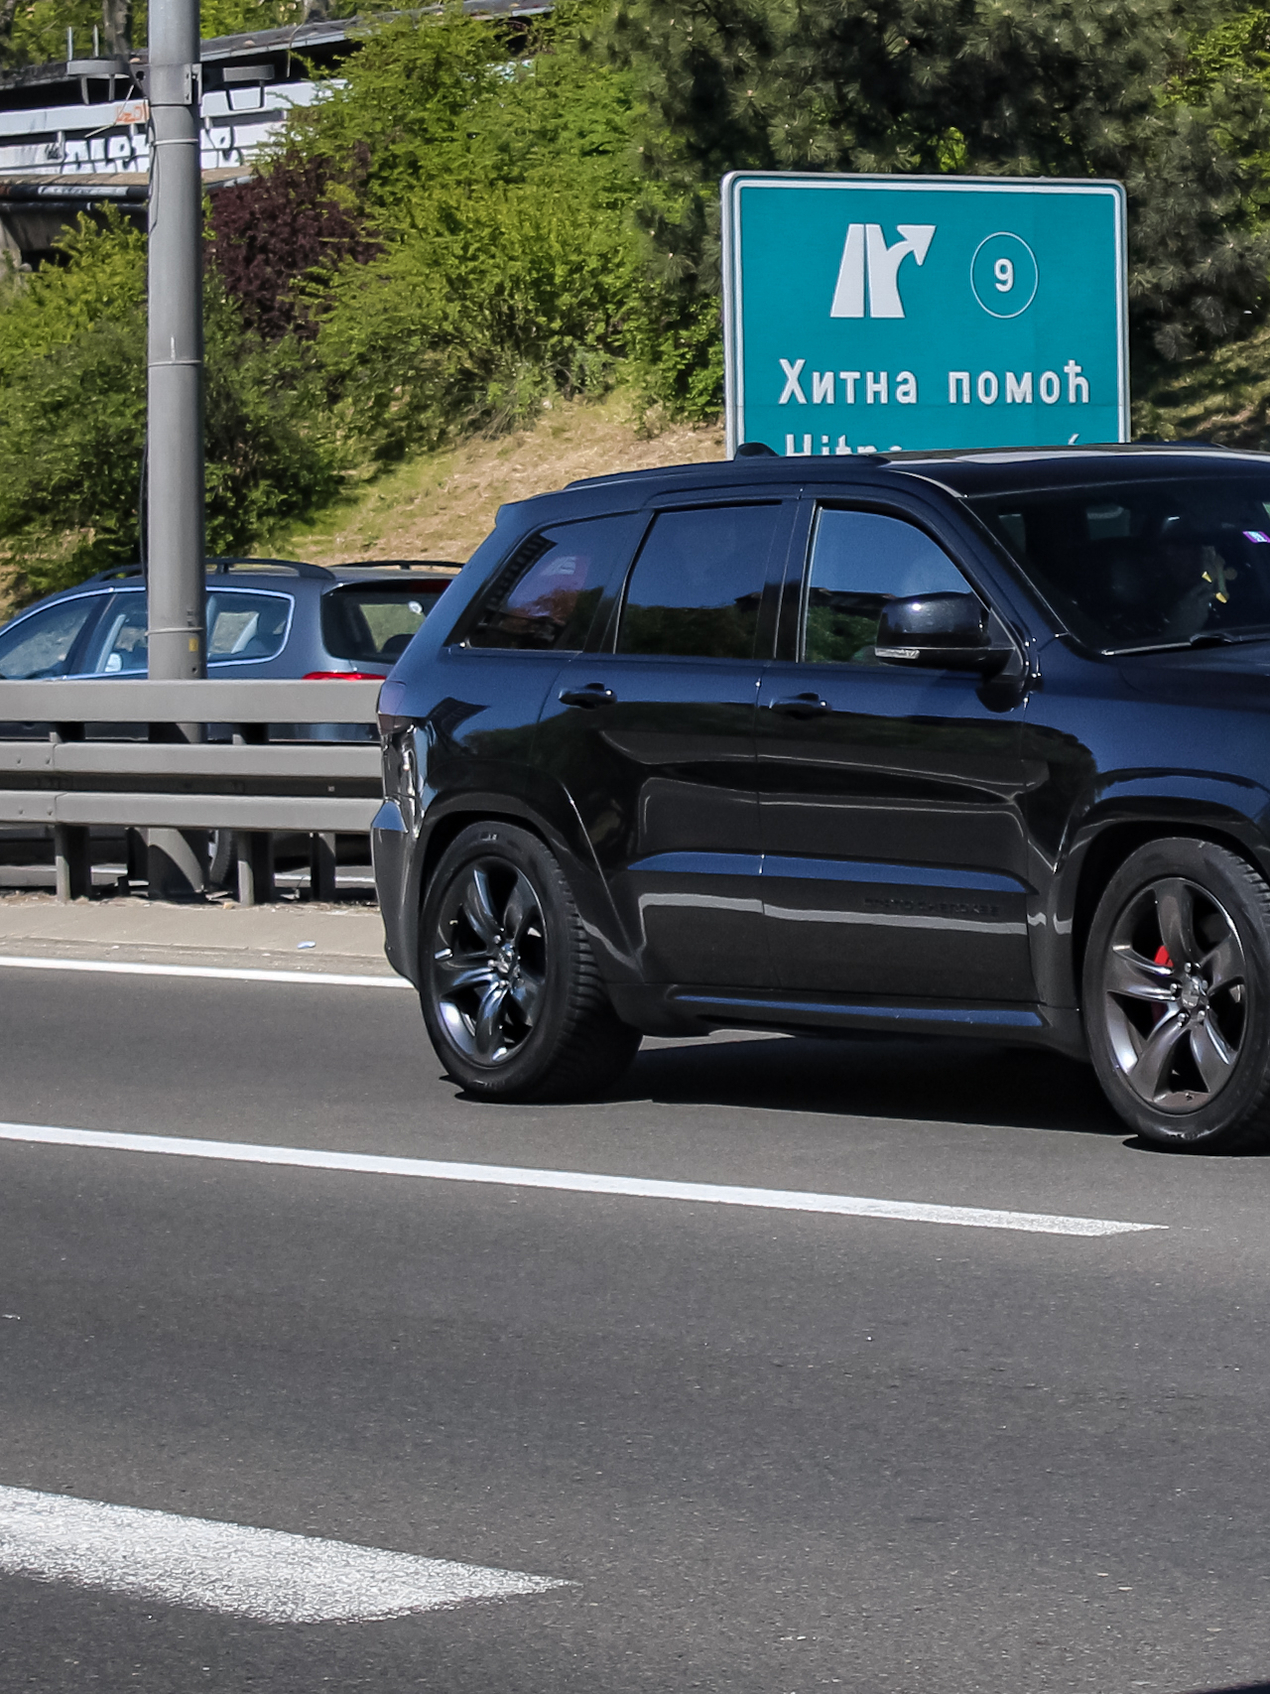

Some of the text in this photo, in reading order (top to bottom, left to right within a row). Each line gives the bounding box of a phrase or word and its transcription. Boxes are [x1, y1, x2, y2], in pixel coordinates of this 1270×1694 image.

[993, 258, 1014, 292] 9
[778, 358, 1089, 404] Хитна помоћ
